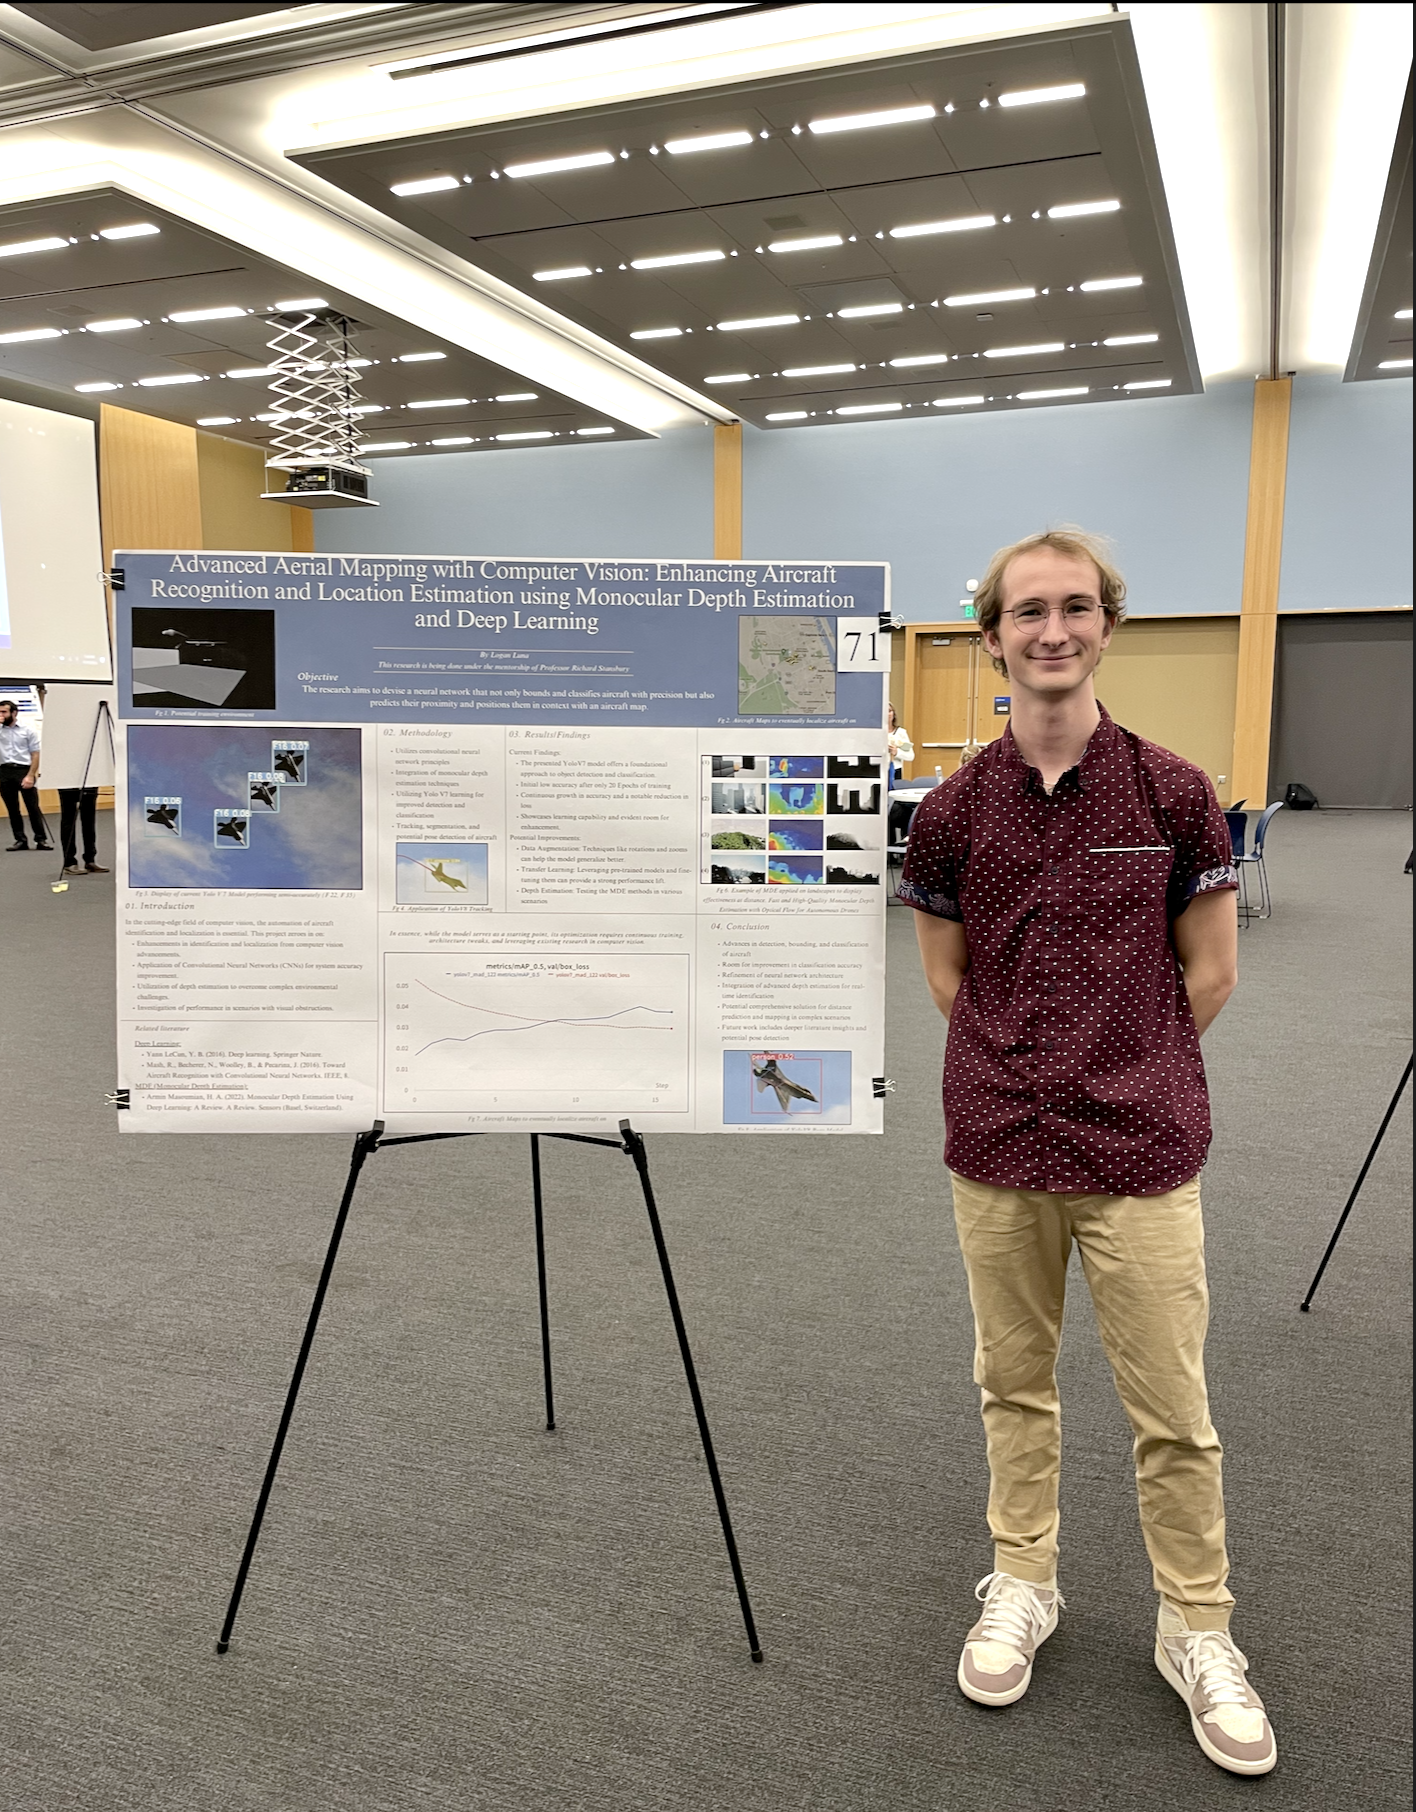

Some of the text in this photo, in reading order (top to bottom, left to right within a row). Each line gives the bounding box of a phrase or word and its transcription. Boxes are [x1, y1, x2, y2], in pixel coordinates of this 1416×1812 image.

[170, 556, 836, 588] Advanced Aerial Mapping with Computer Vision: Enhancing Aircraft
[152, 580, 854, 612] Recognition and Location Estimation using Monocular Depth Estimation
[415, 609, 599, 634] and Deep Learning
[845, 632, 882, 661] 71
[298, 672, 338, 683] Objective
[504, 689, 521, 698] only
[370, 699, 400, 708] predicts
[399, 729, 453, 738] Methodology
[525, 731, 590, 740] Results/Findings
